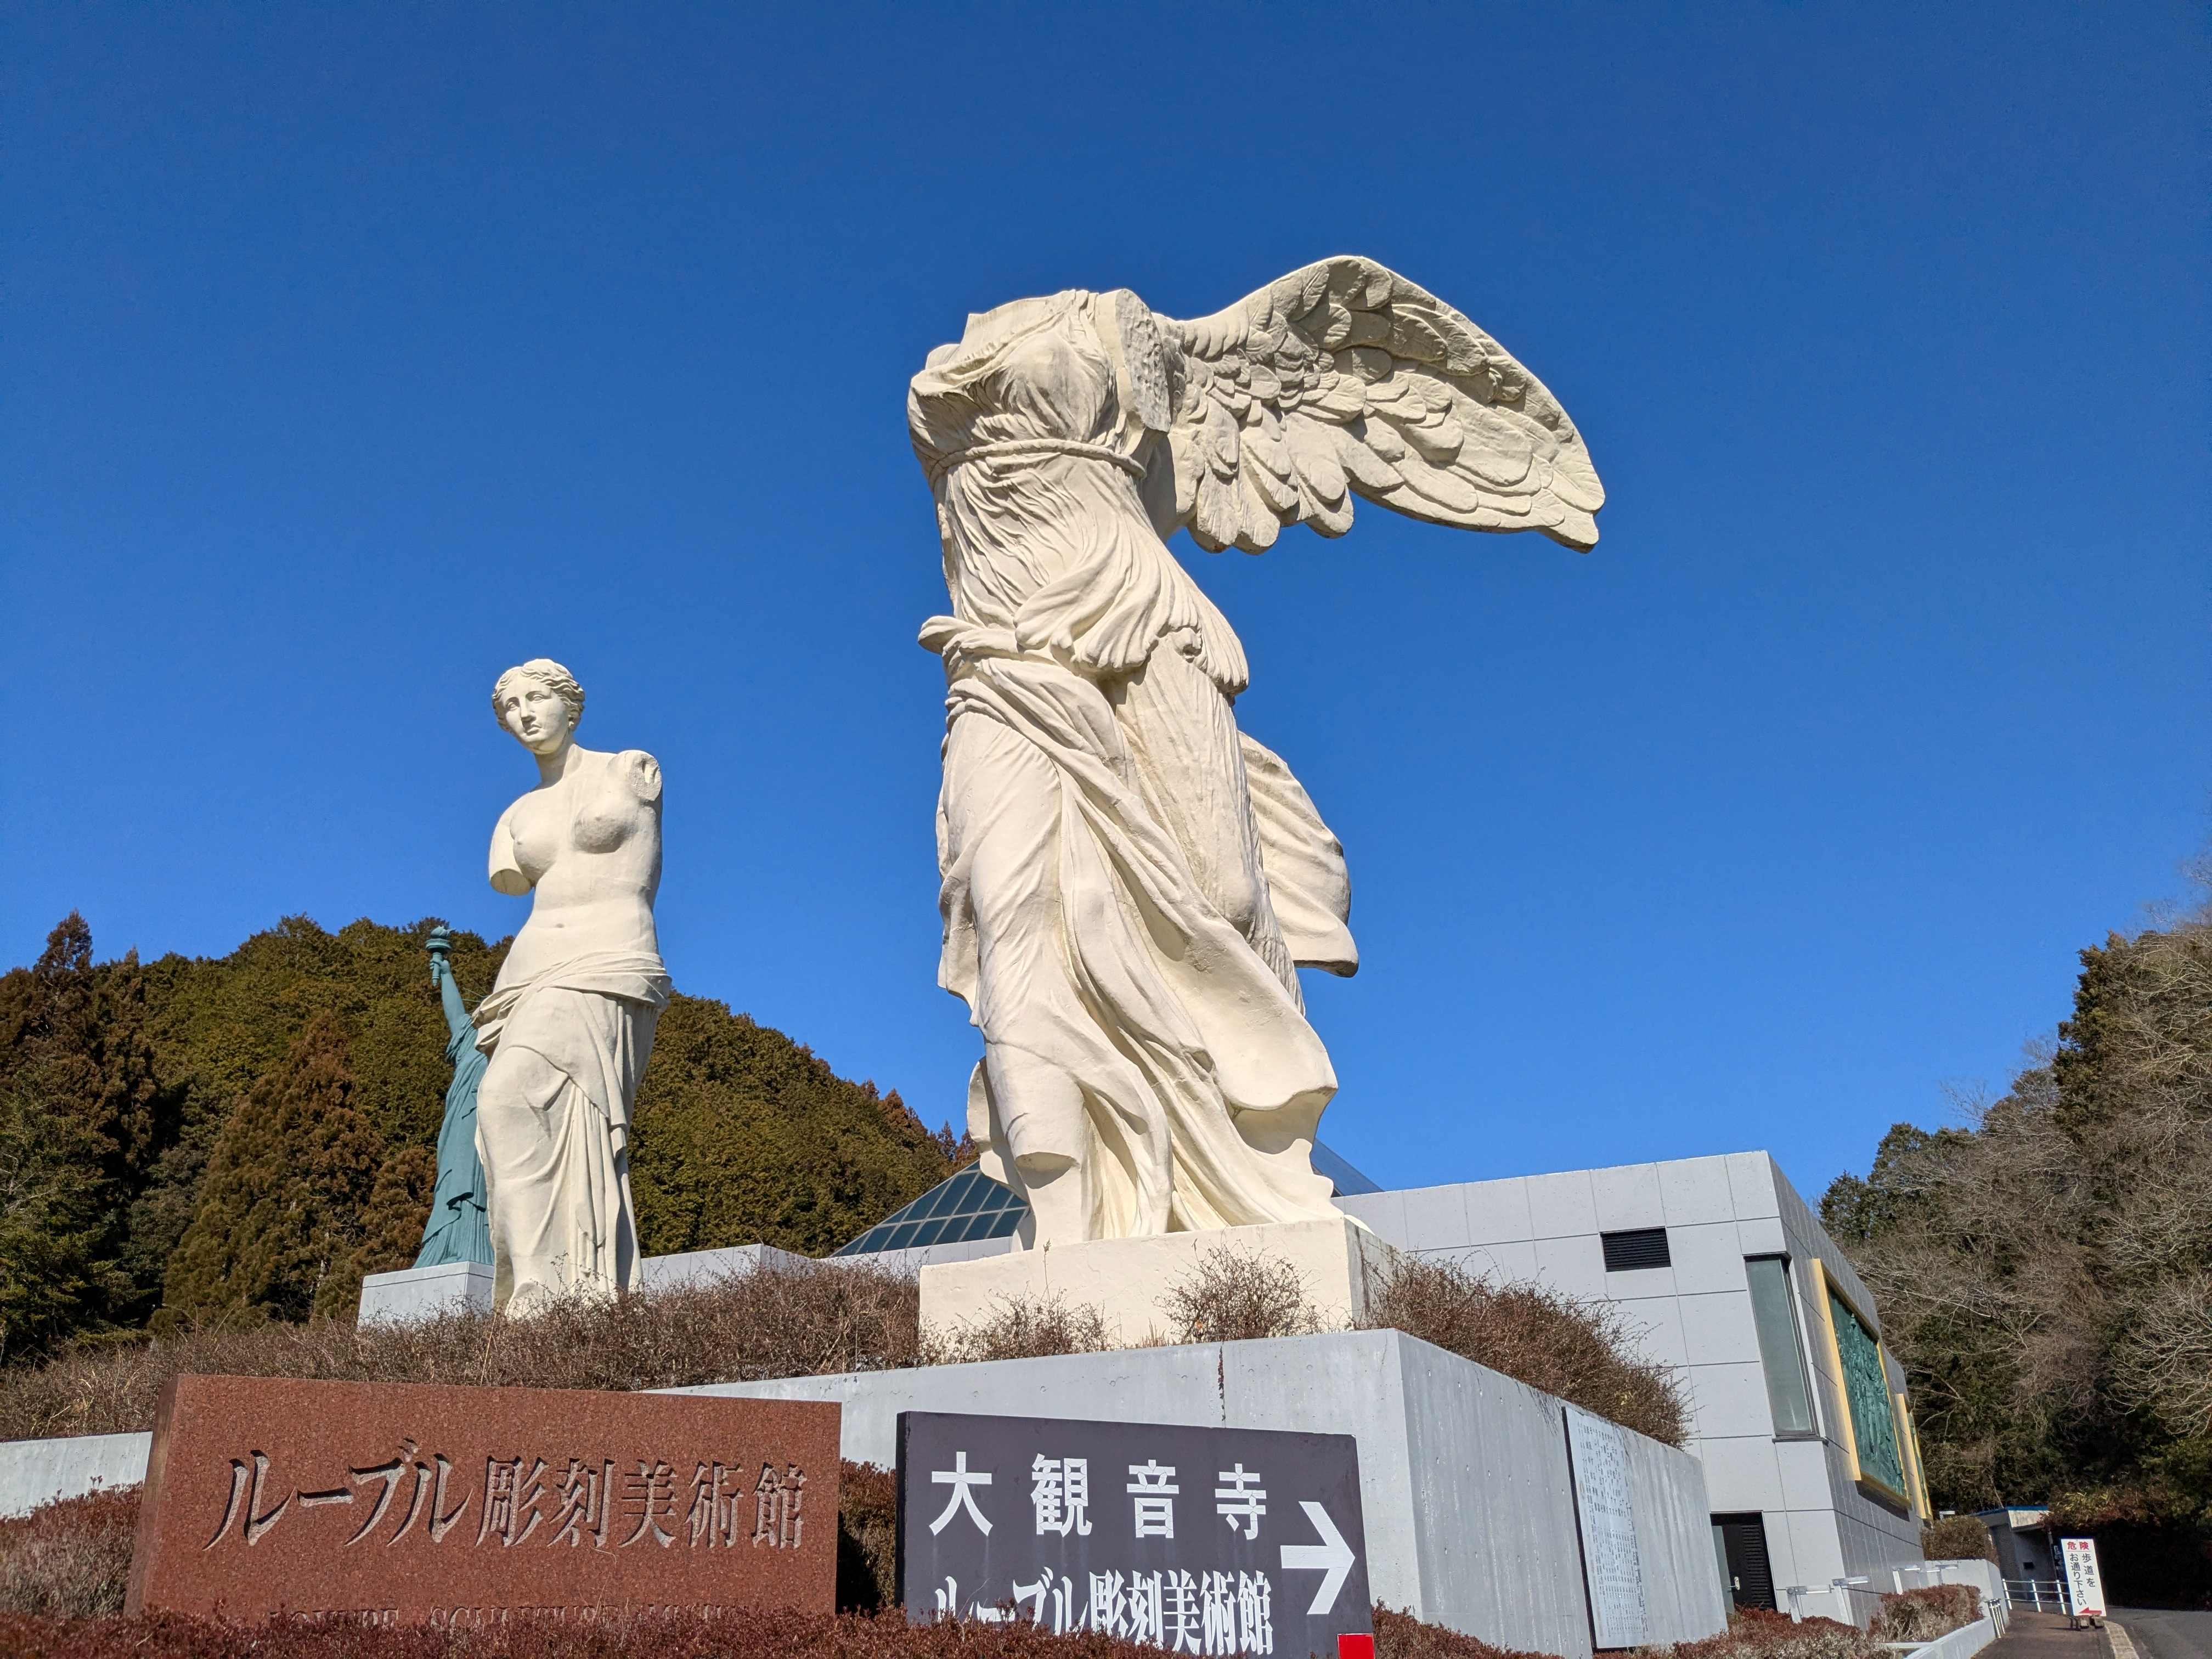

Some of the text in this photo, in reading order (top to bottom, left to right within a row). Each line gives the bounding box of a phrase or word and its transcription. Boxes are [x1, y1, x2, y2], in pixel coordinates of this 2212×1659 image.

[203, 1437, 806, 1551] ルーブル彫刻美術館
[929, 1451, 1267, 1541] 大観音寺
[2069, 1553, 2086, 1605] お通り下さい
[2081, 1553, 2096, 1587] 歩道を
